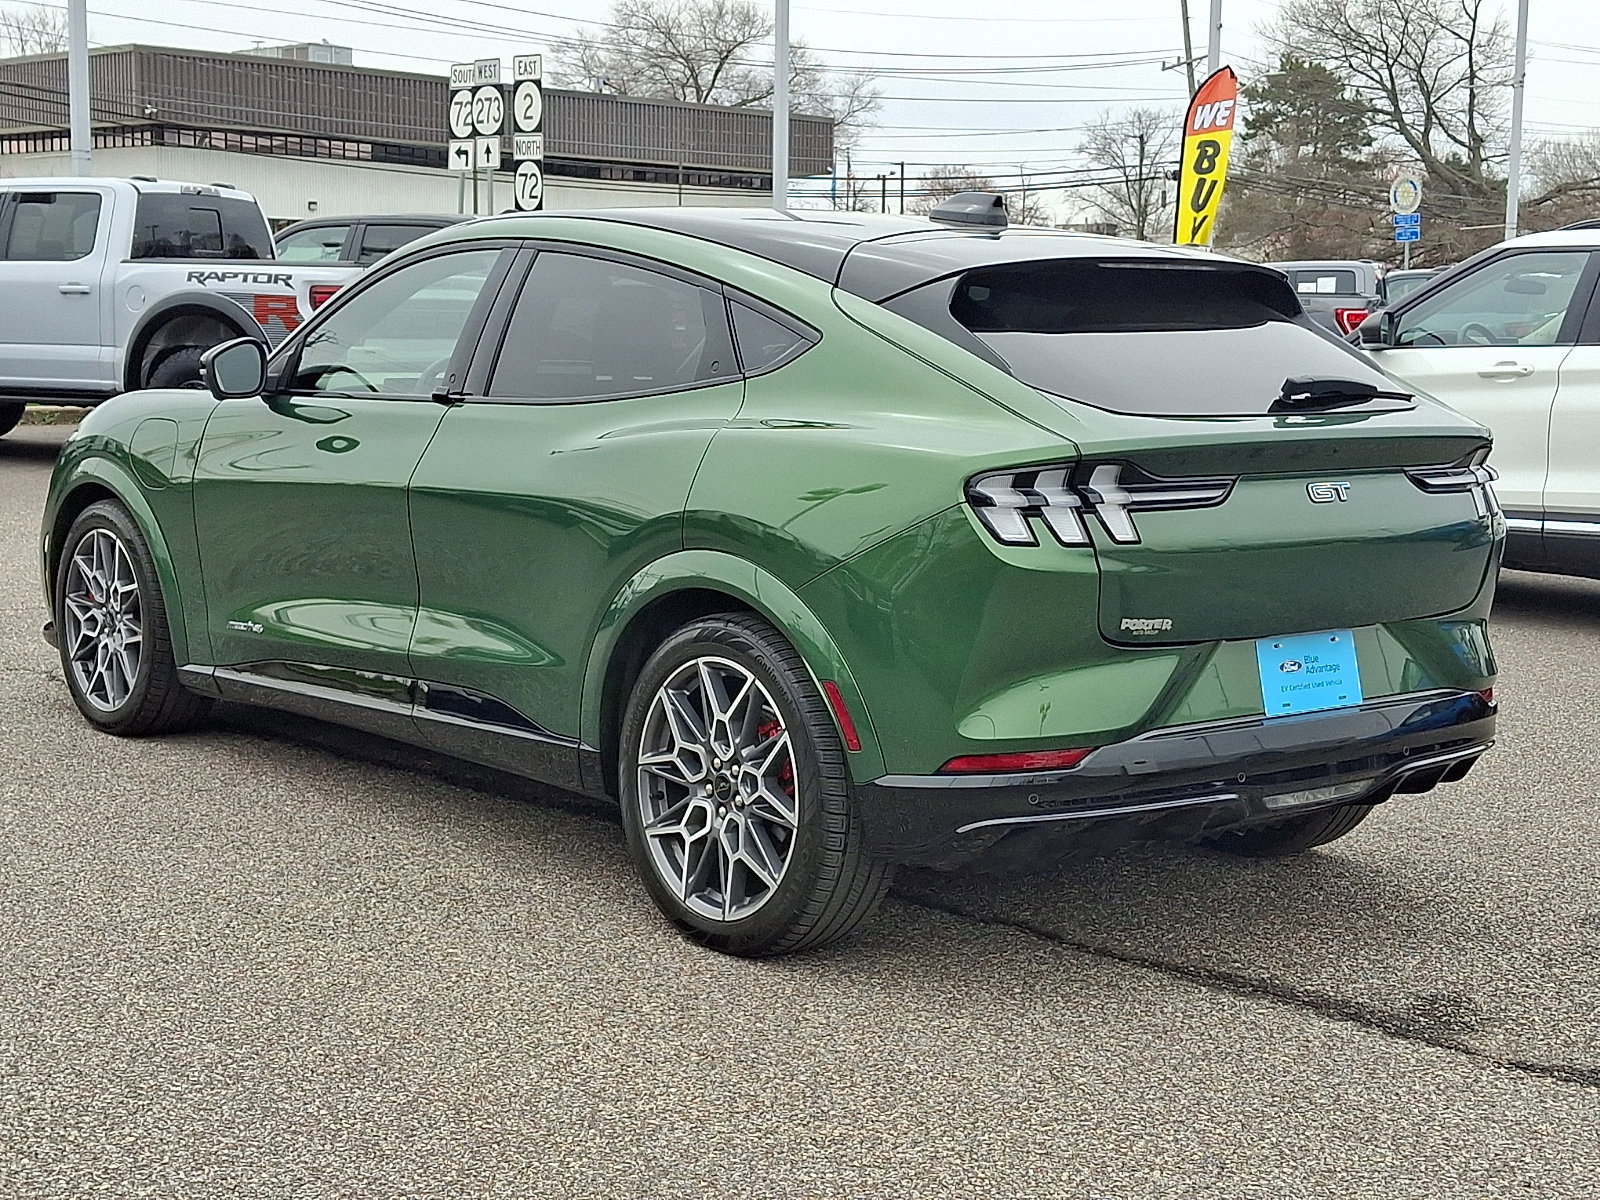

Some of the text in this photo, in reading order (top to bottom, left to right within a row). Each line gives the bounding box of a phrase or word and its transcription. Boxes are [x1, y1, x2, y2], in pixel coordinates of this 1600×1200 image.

[478, 64, 497, 79] WEST
[518, 60, 537, 76] EAST
[453, 101, 473, 127] 72
[475, 96, 501, 124] 273
[523, 93, 534, 120] 2
[1193, 100, 1235, 131] WE
[515, 140, 541, 156] NORTH
[518, 172, 539, 199] 72
[1190, 139, 1221, 243] BUY
[186, 271, 296, 291] RAPTOR
[253, 294, 302, 333] R
[1306, 481, 1351, 503] GT
[1120, 618, 1173, 631] PORTER
[1281, 660, 1302, 672] Ford
[1303, 655, 1320, 664] Blue
[1305, 663, 1341, 674] Advantage
